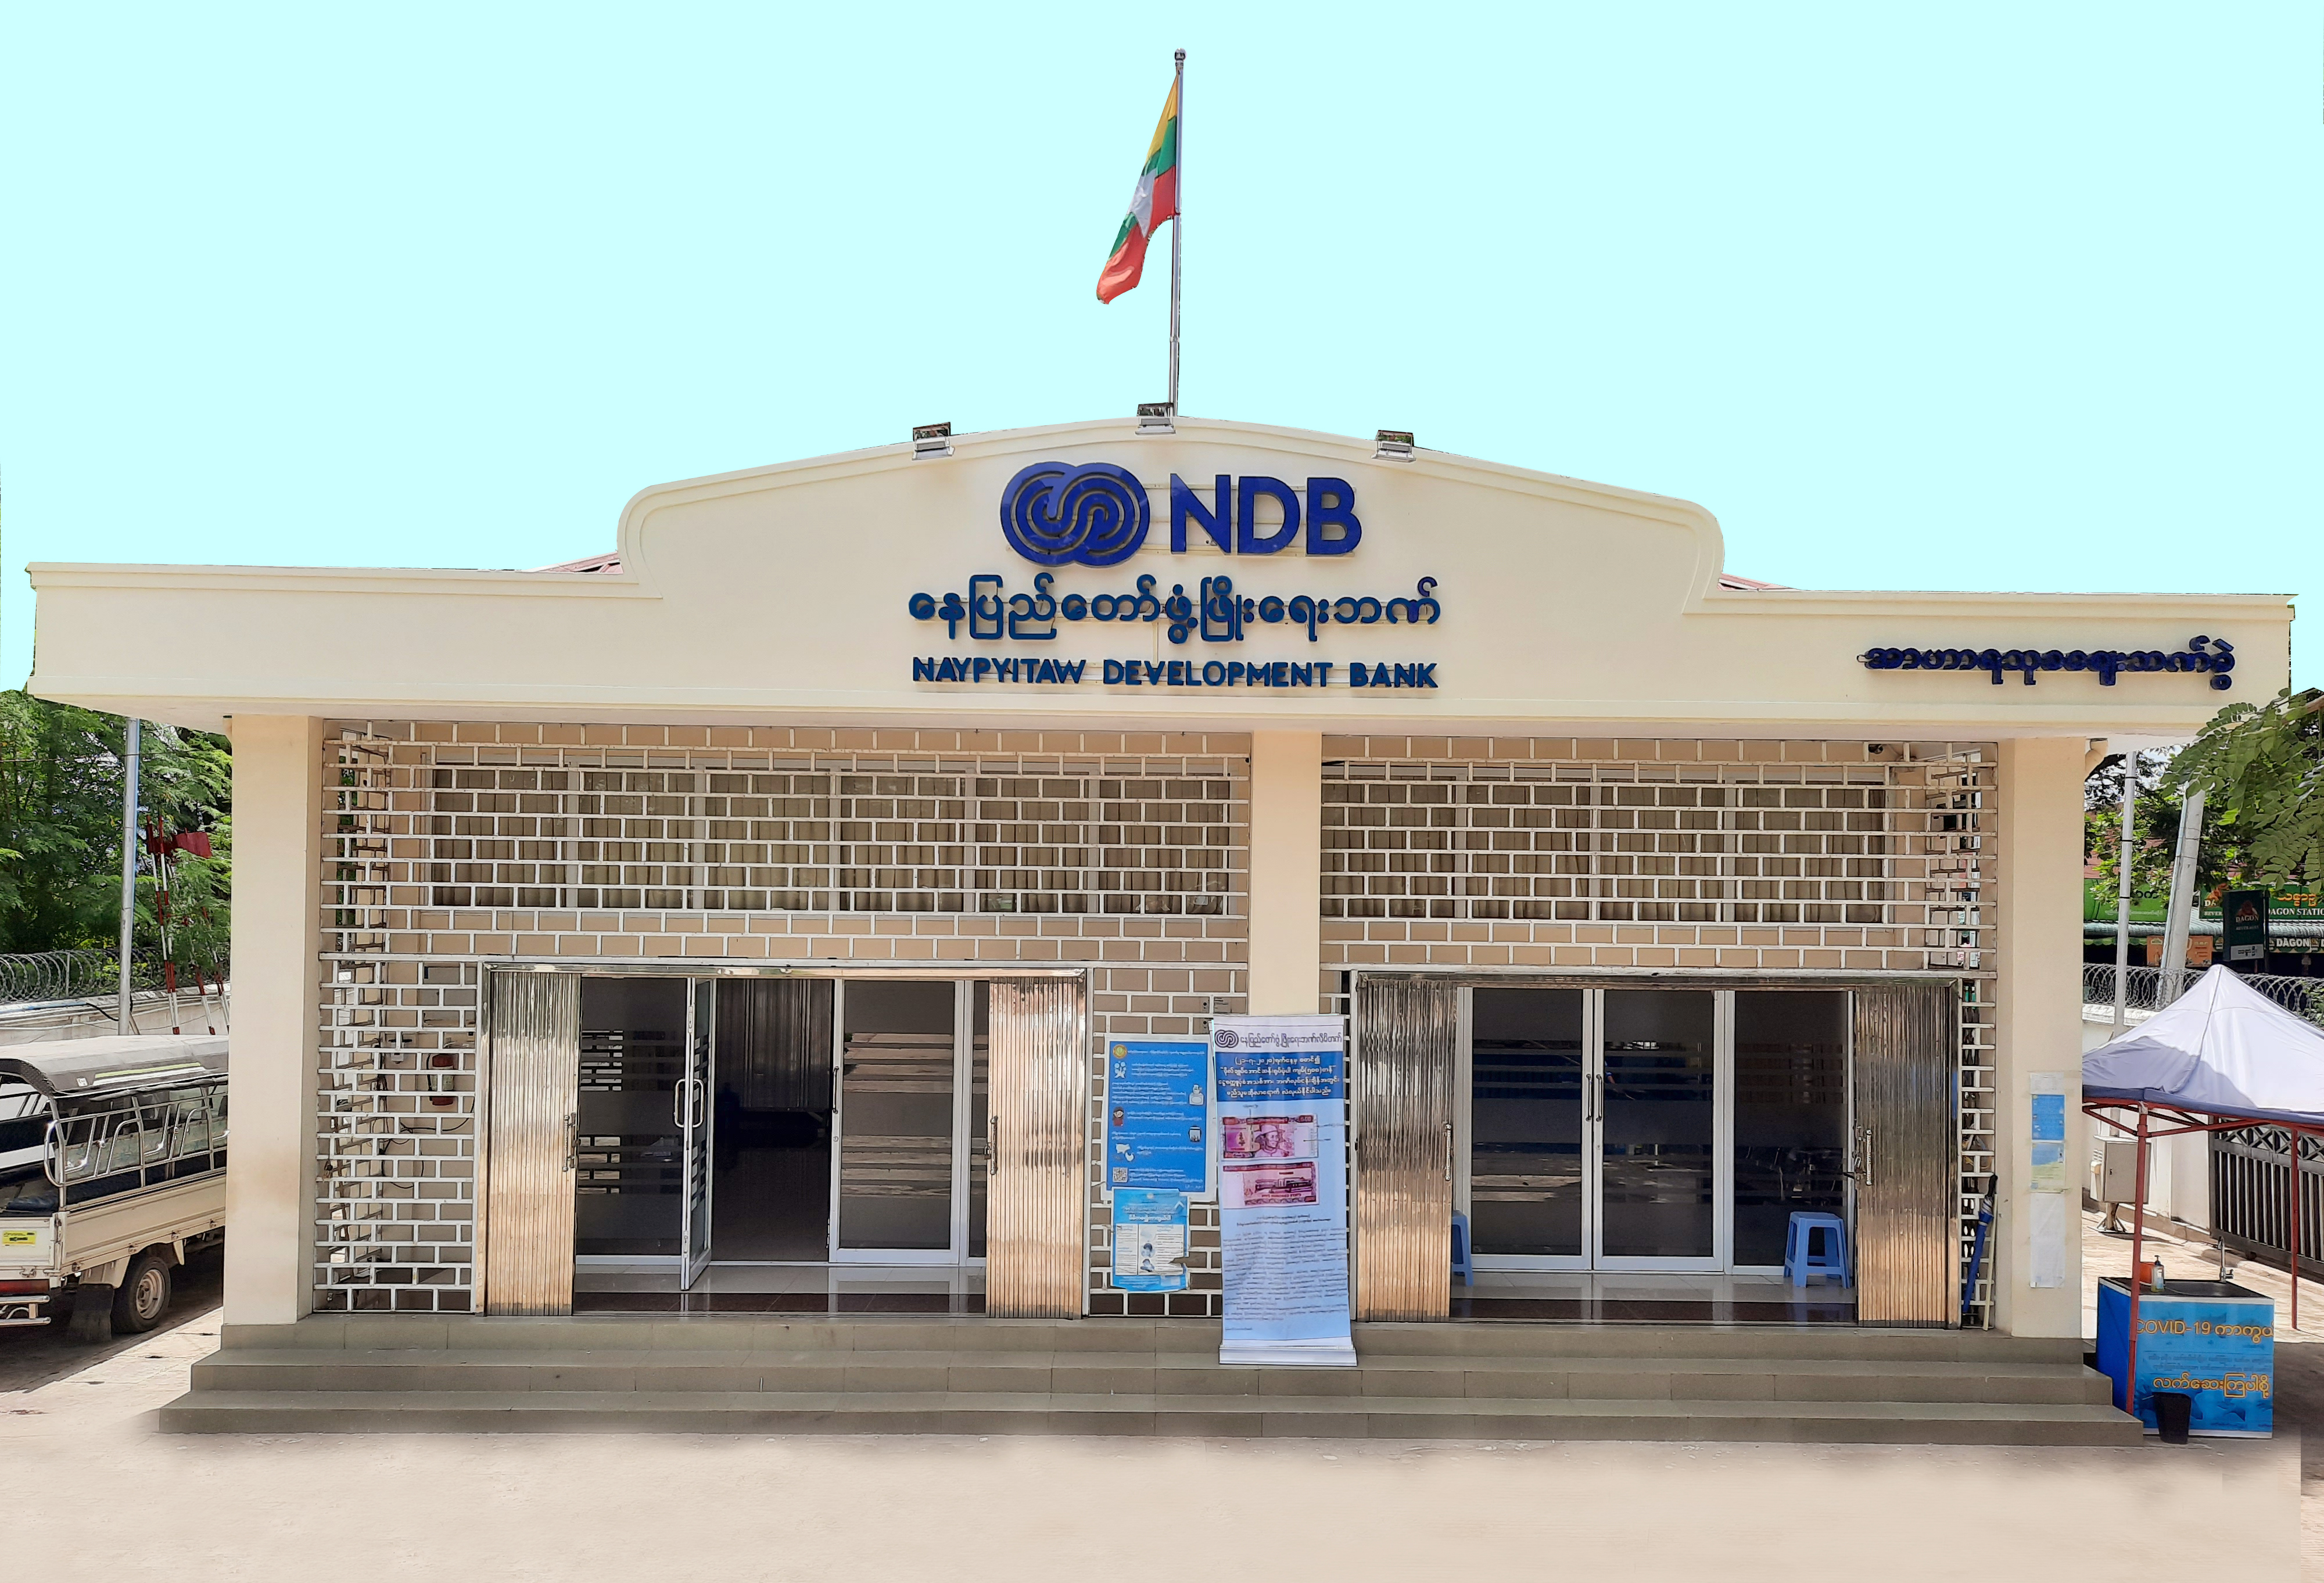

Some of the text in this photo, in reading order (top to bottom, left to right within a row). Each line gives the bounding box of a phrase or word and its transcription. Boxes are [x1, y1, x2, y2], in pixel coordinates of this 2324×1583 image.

[1170, 473, 1362, 556] NDB
[909, 572, 1440, 644] နေပြည်တော်ဖွံ့ဖြိုးရေးဘဏ်
[912, 656, 1439, 689] NAYPYITAW DEVELOPMENT BANK
[2235, 914, 2260, 923] DAGON
[2296, 907, 2324, 916] STATIO
[2276, 938, 2311, 947] DAGON
[2137, 1319, 2211, 1335] COVID-19
